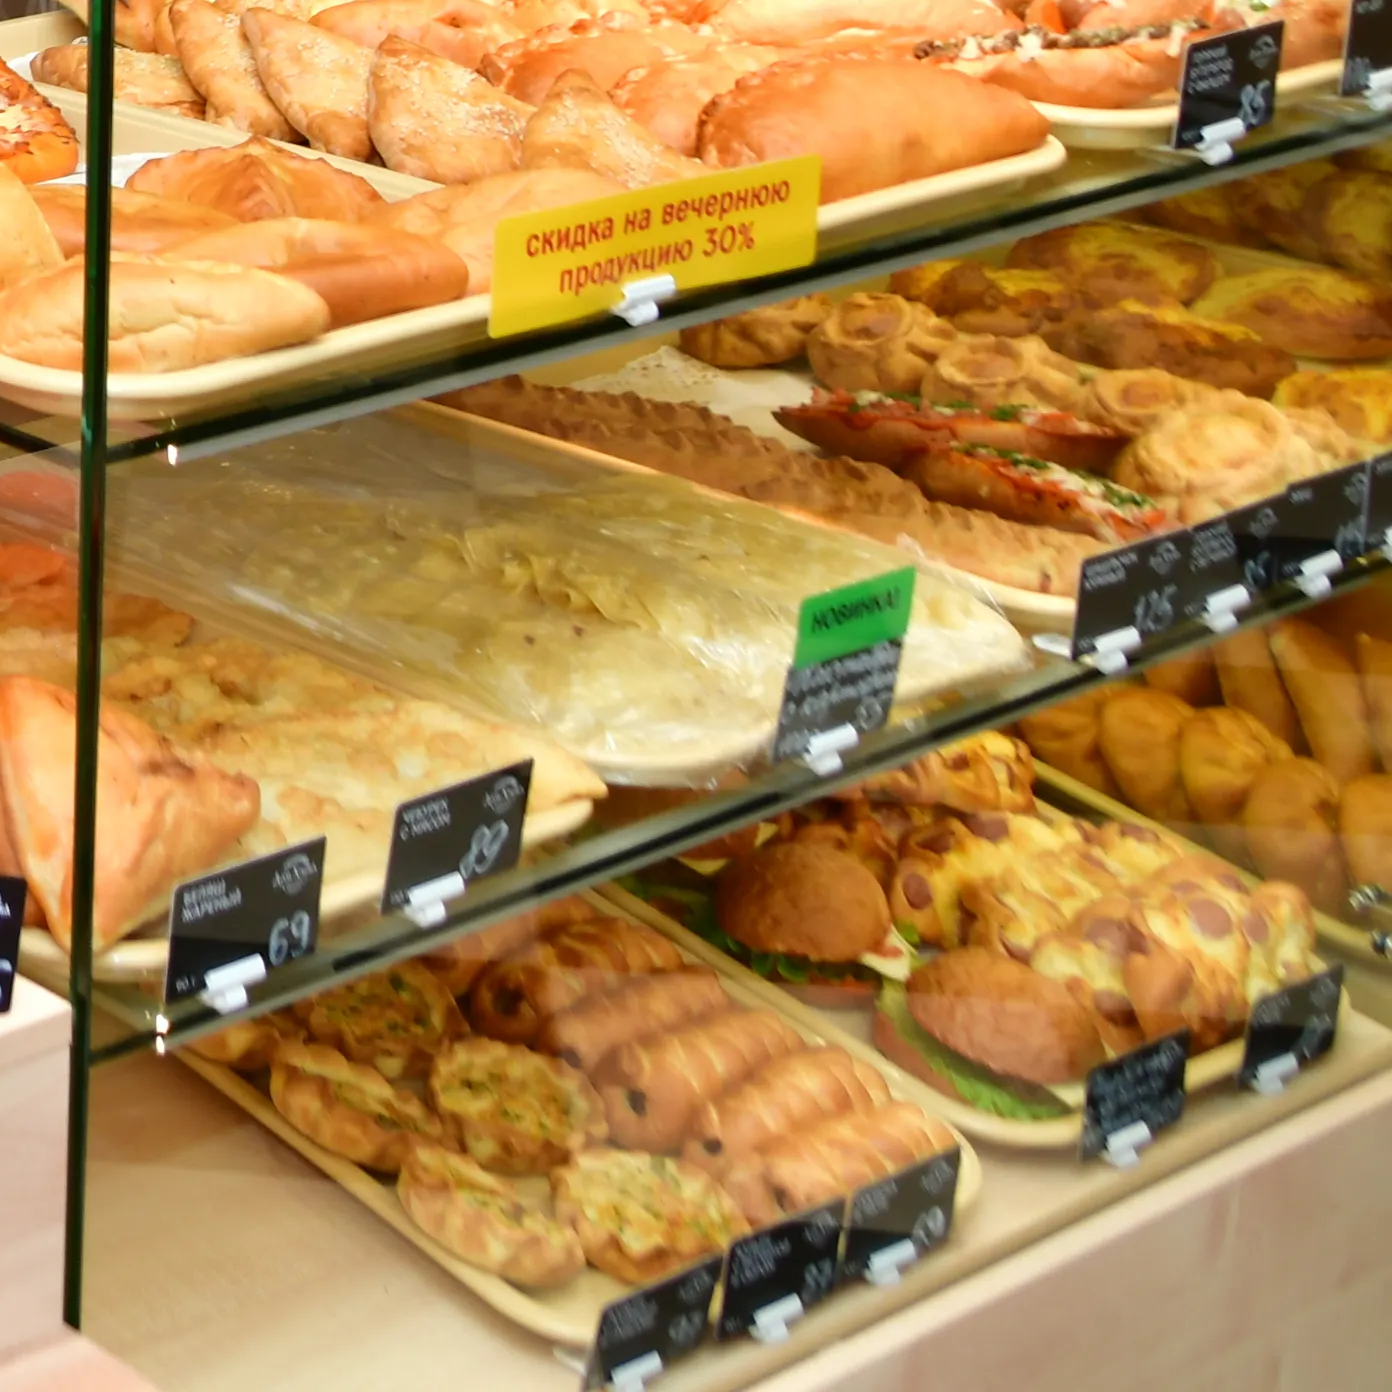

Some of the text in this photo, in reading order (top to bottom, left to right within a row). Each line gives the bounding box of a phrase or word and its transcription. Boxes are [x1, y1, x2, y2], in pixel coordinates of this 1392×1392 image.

[624, 208, 651, 234] на
[662, 178, 790, 224] вечернюю
[559, 221, 756, 296] продукцию 30%
[269, 910, 309, 967] 69
